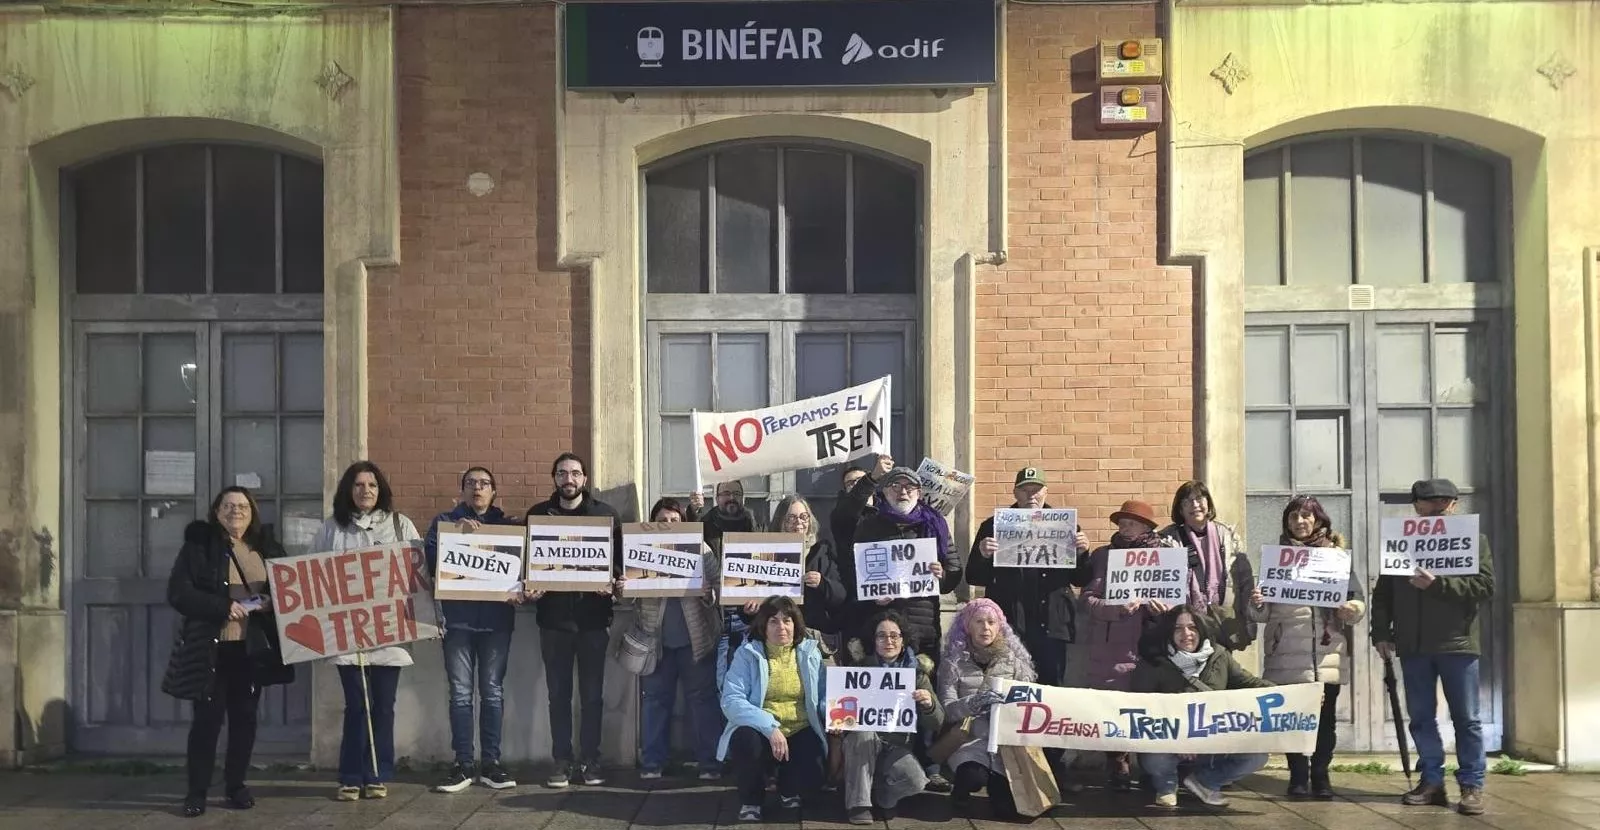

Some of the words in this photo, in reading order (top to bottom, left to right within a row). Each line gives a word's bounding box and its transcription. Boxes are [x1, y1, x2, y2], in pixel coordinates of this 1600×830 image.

[681, 20, 823, 60] BINÉFAR
[877, 38, 945, 58] adif
[703, 417, 763, 472] NO
[762, 402, 839, 436] PERDAMOS
[844, 394, 868, 412] EL
[805, 417, 884, 461] TREN
[919, 475, 937, 489] REN
[997, 529, 1024, 541] TREN
[1025, 529, 1034, 540] A
[1037, 529, 1074, 540] LLEIDA
[1403, 518, 1447, 536] DGA
[533, 546, 545, 558] A
[549, 547, 608, 559] MEDIDA
[891, 543, 916, 562] NO
[1386, 540, 1408, 553] NO
[1415, 537, 1472, 552] ROBES
[443, 550, 511, 575] ANDÉN
[628, 549, 656, 564] DEL
[657, 554, 698, 571] TREN
[1016, 543, 1058, 566] ¡YA!
[1125, 550, 1160, 567] DGA
[1279, 547, 1310, 568] DG
[1384, 559, 1411, 569] LOS
[1415, 556, 1474, 570] TRENES
[727, 562, 745, 573] EN
[747, 563, 800, 578] BINÉFAR
[912, 562, 932, 576] AL
[1111, 570, 1129, 583] NO
[1134, 569, 1180, 582] ROBES
[1108, 588, 1131, 600] LOS
[1134, 588, 1182, 599] TRENES
[1260, 586, 1277, 598] ES
[1280, 587, 1342, 603] NUESTRO
[328, 597, 418, 651] TREN
[844, 670, 872, 690] NO
[879, 671, 906, 690] AL
[1004, 685, 1042, 704] EN
